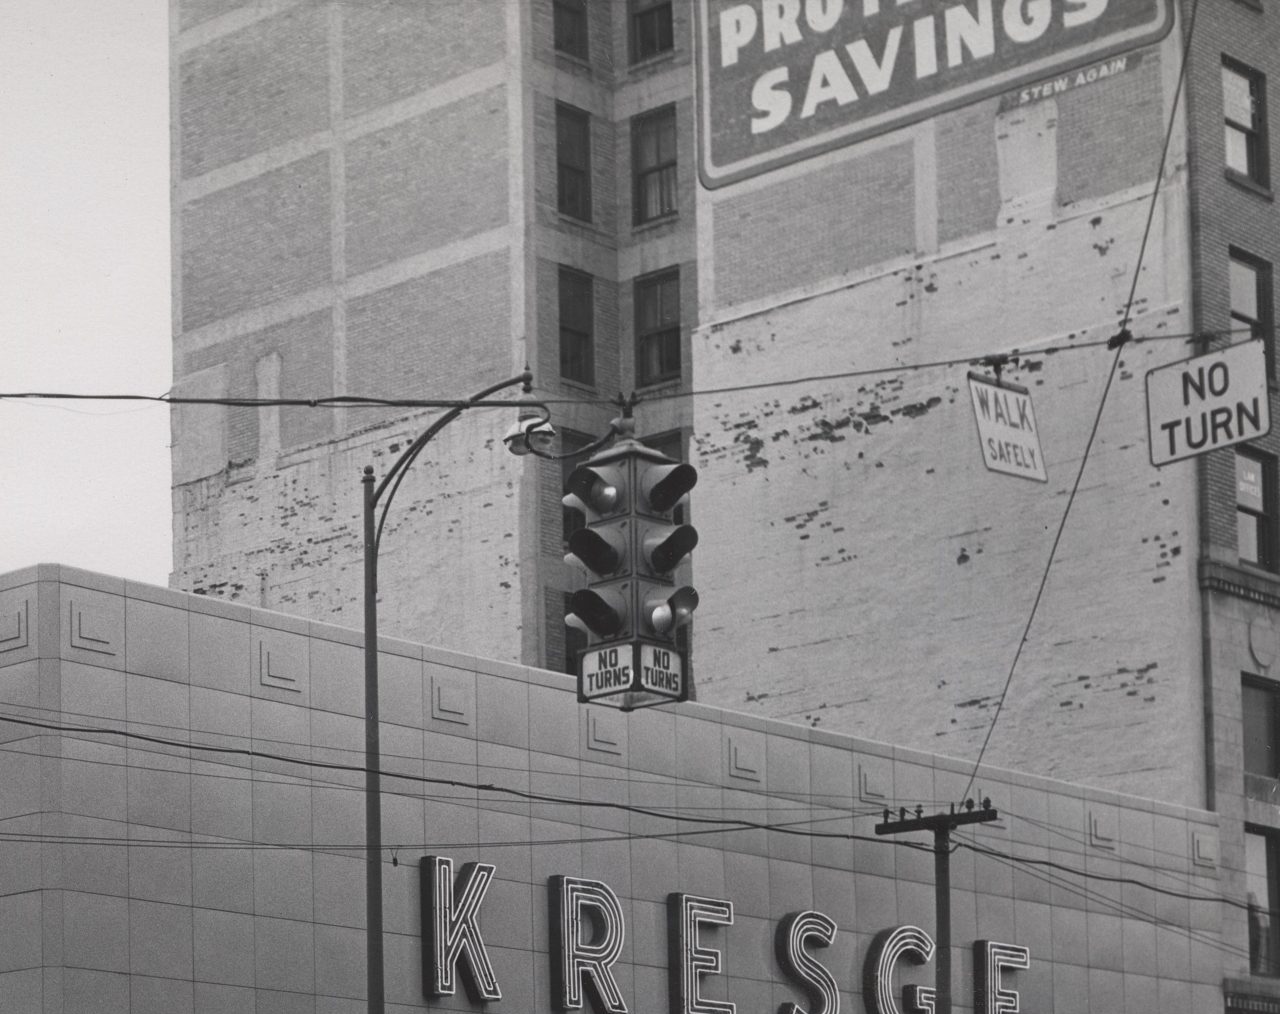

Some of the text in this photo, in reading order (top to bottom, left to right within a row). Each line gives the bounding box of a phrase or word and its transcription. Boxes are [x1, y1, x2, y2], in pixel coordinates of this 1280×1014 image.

[1075, 57, 1127, 86] AGAIN
[1182, 361, 1230, 407] NO
[974, 386, 1034, 433] WALK
[1160, 397, 1261, 456] TURN
[987, 437, 1038, 470] SAFELY
[598, 648, 619, 670] NO
[652, 648, 670, 670] NO
[587, 666, 630, 691] TURNS
[644, 666, 679, 692] TURNS
